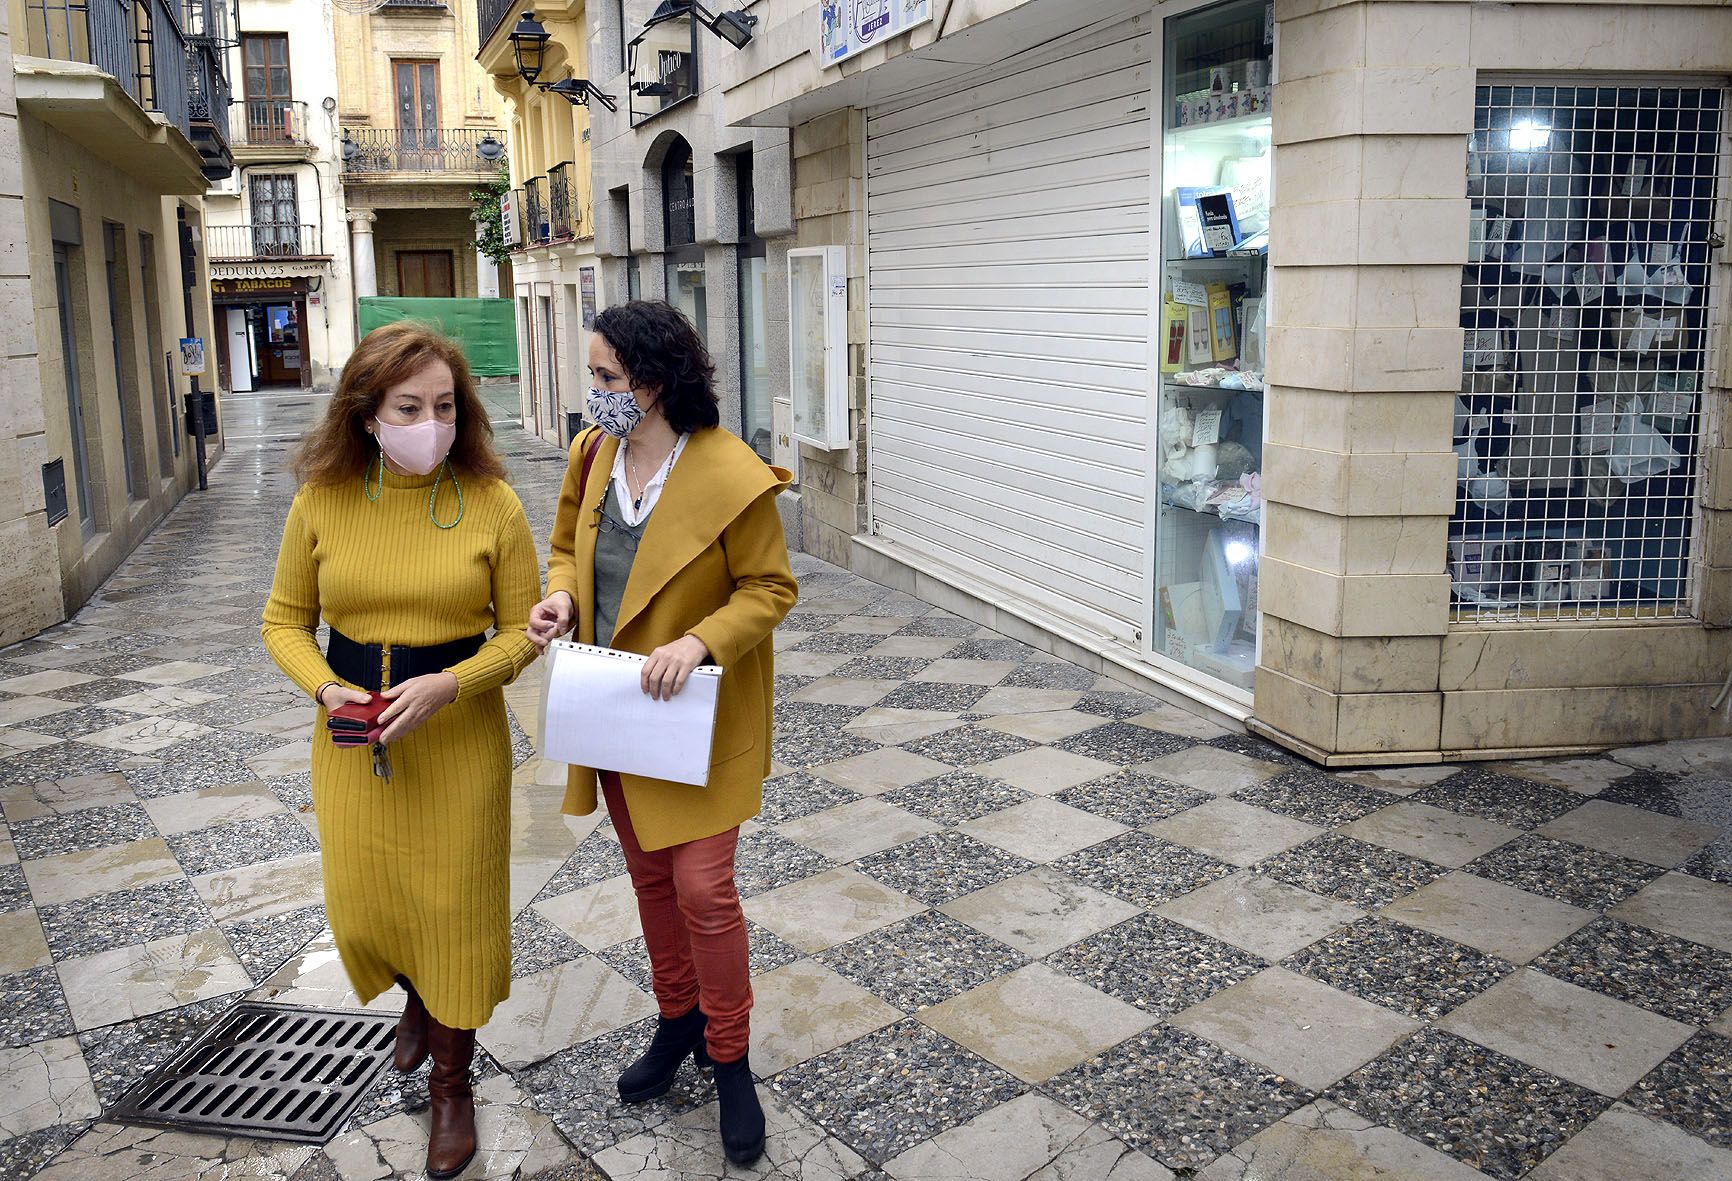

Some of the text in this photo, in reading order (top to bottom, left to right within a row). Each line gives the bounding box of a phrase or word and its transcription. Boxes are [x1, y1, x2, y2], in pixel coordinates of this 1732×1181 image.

[868, 17, 883, 32] JEREZ
[669, 199, 686, 213] CENTRO
[270, 265, 284, 275] 25
[235, 279, 292, 289] TABACOS
